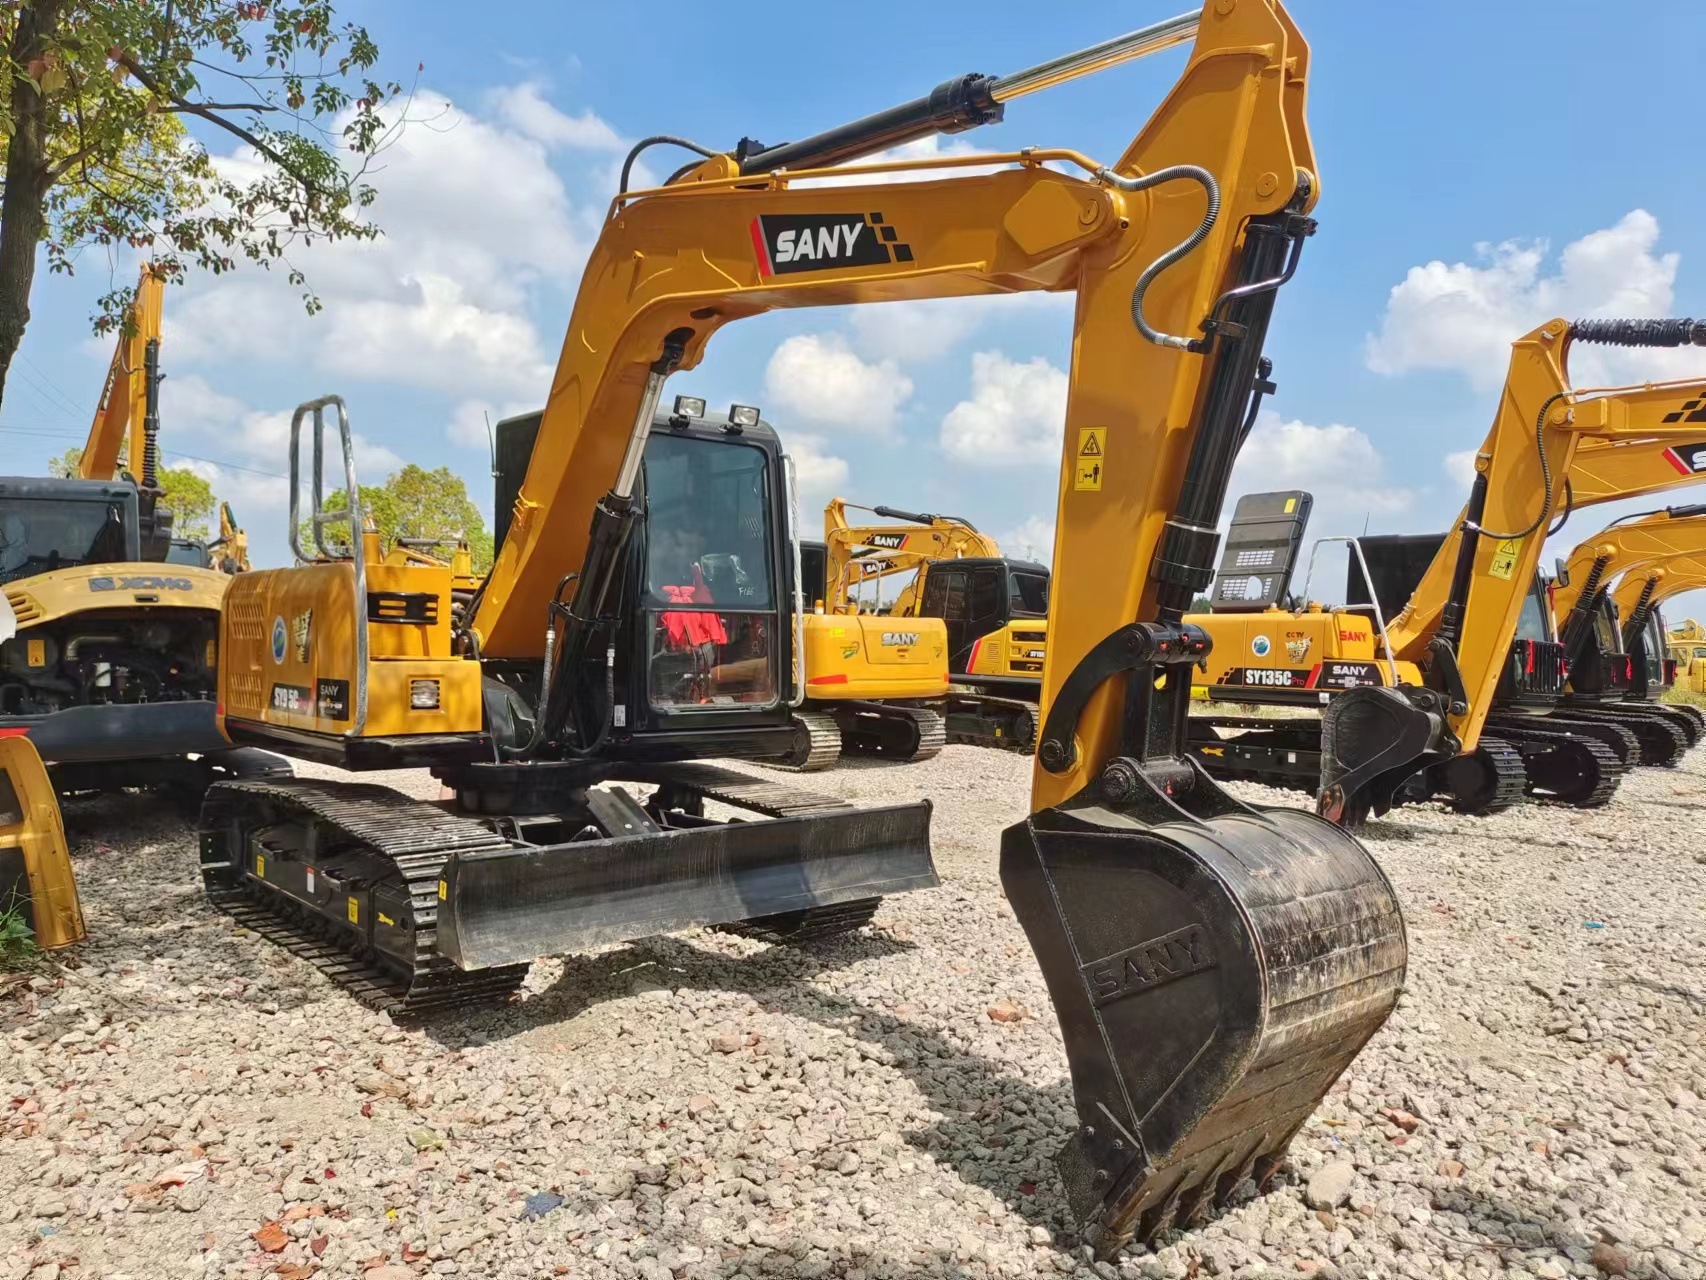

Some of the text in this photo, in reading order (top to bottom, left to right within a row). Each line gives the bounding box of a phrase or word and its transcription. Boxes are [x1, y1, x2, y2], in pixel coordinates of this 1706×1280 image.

[775, 222, 864, 263] SANY
[874, 535, 900, 547] SANY
[118, 577, 192, 591] XCMG
[881, 632, 920, 646] SANY
[1286, 631, 1304, 639] CCTV
[1339, 630, 1367, 642] SANY
[1332, 665, 1368, 676] SANY
[1246, 669, 1304, 686] SY135C Pro
[320, 685, 339, 696] SANY
[1094, 932, 1201, 999] SANY
